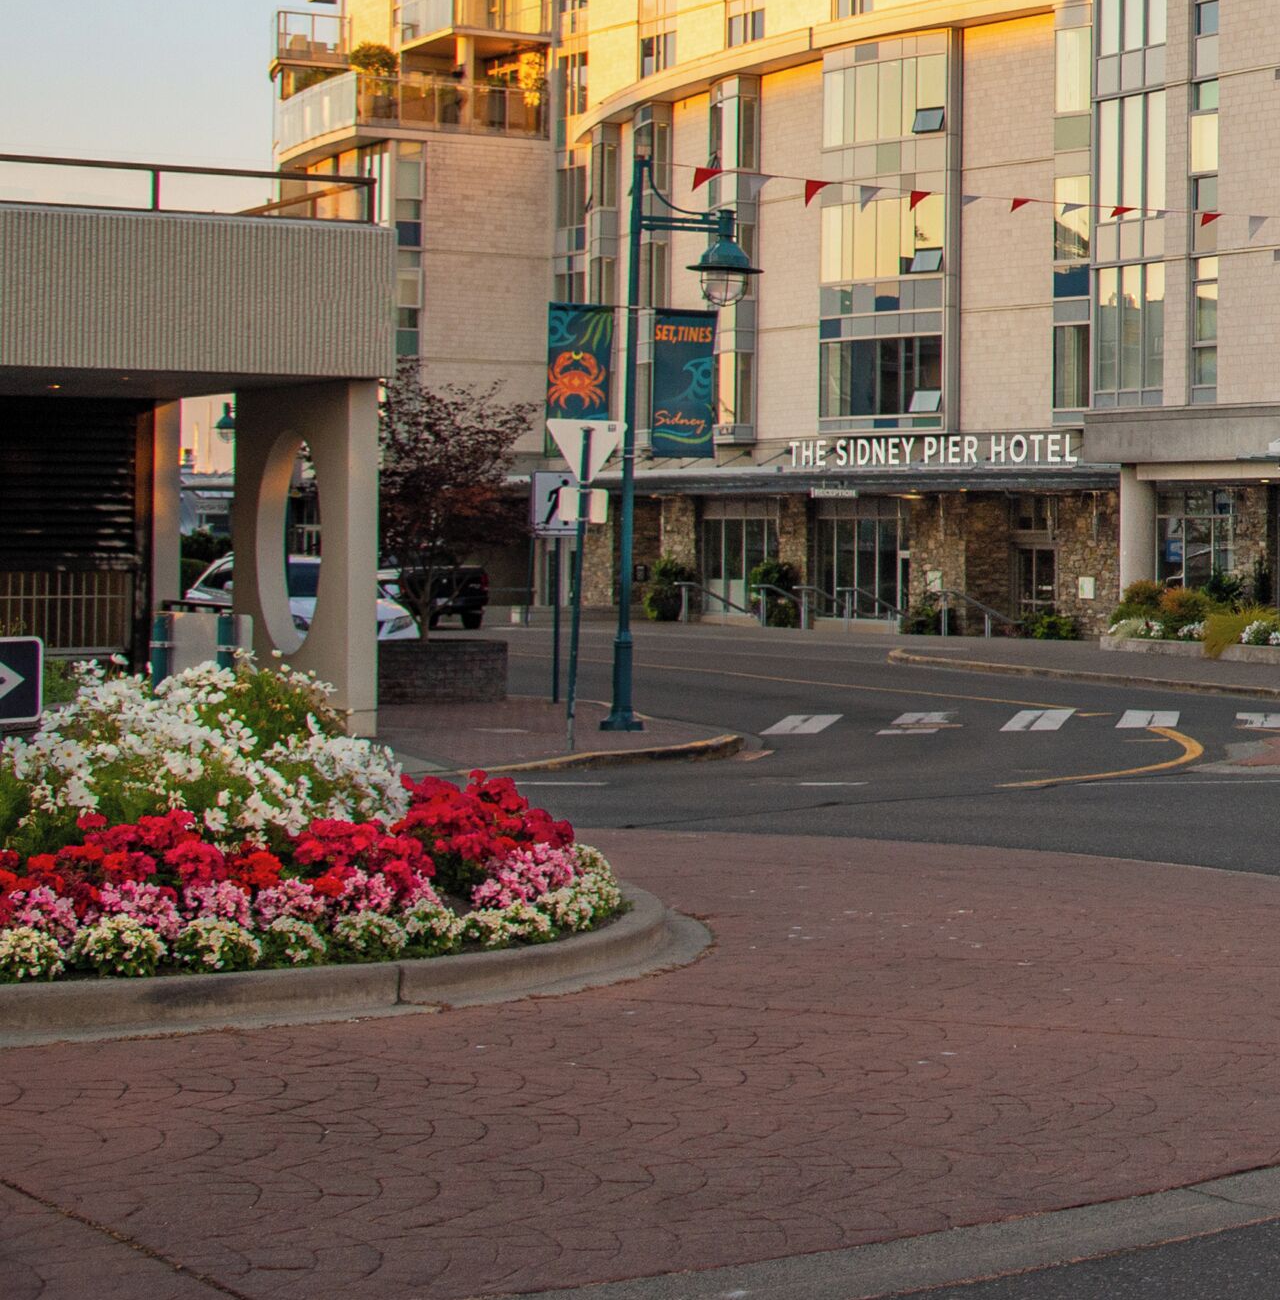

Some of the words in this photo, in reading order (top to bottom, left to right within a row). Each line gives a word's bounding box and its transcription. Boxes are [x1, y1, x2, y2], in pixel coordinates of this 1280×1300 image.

[655, 410, 706, 435] Sidney
[789, 440, 827, 467] THE
[836, 437, 915, 467] SIDNEY
[924, 434, 978, 464] PIER
[990, 434, 1078, 463] HOTEL
